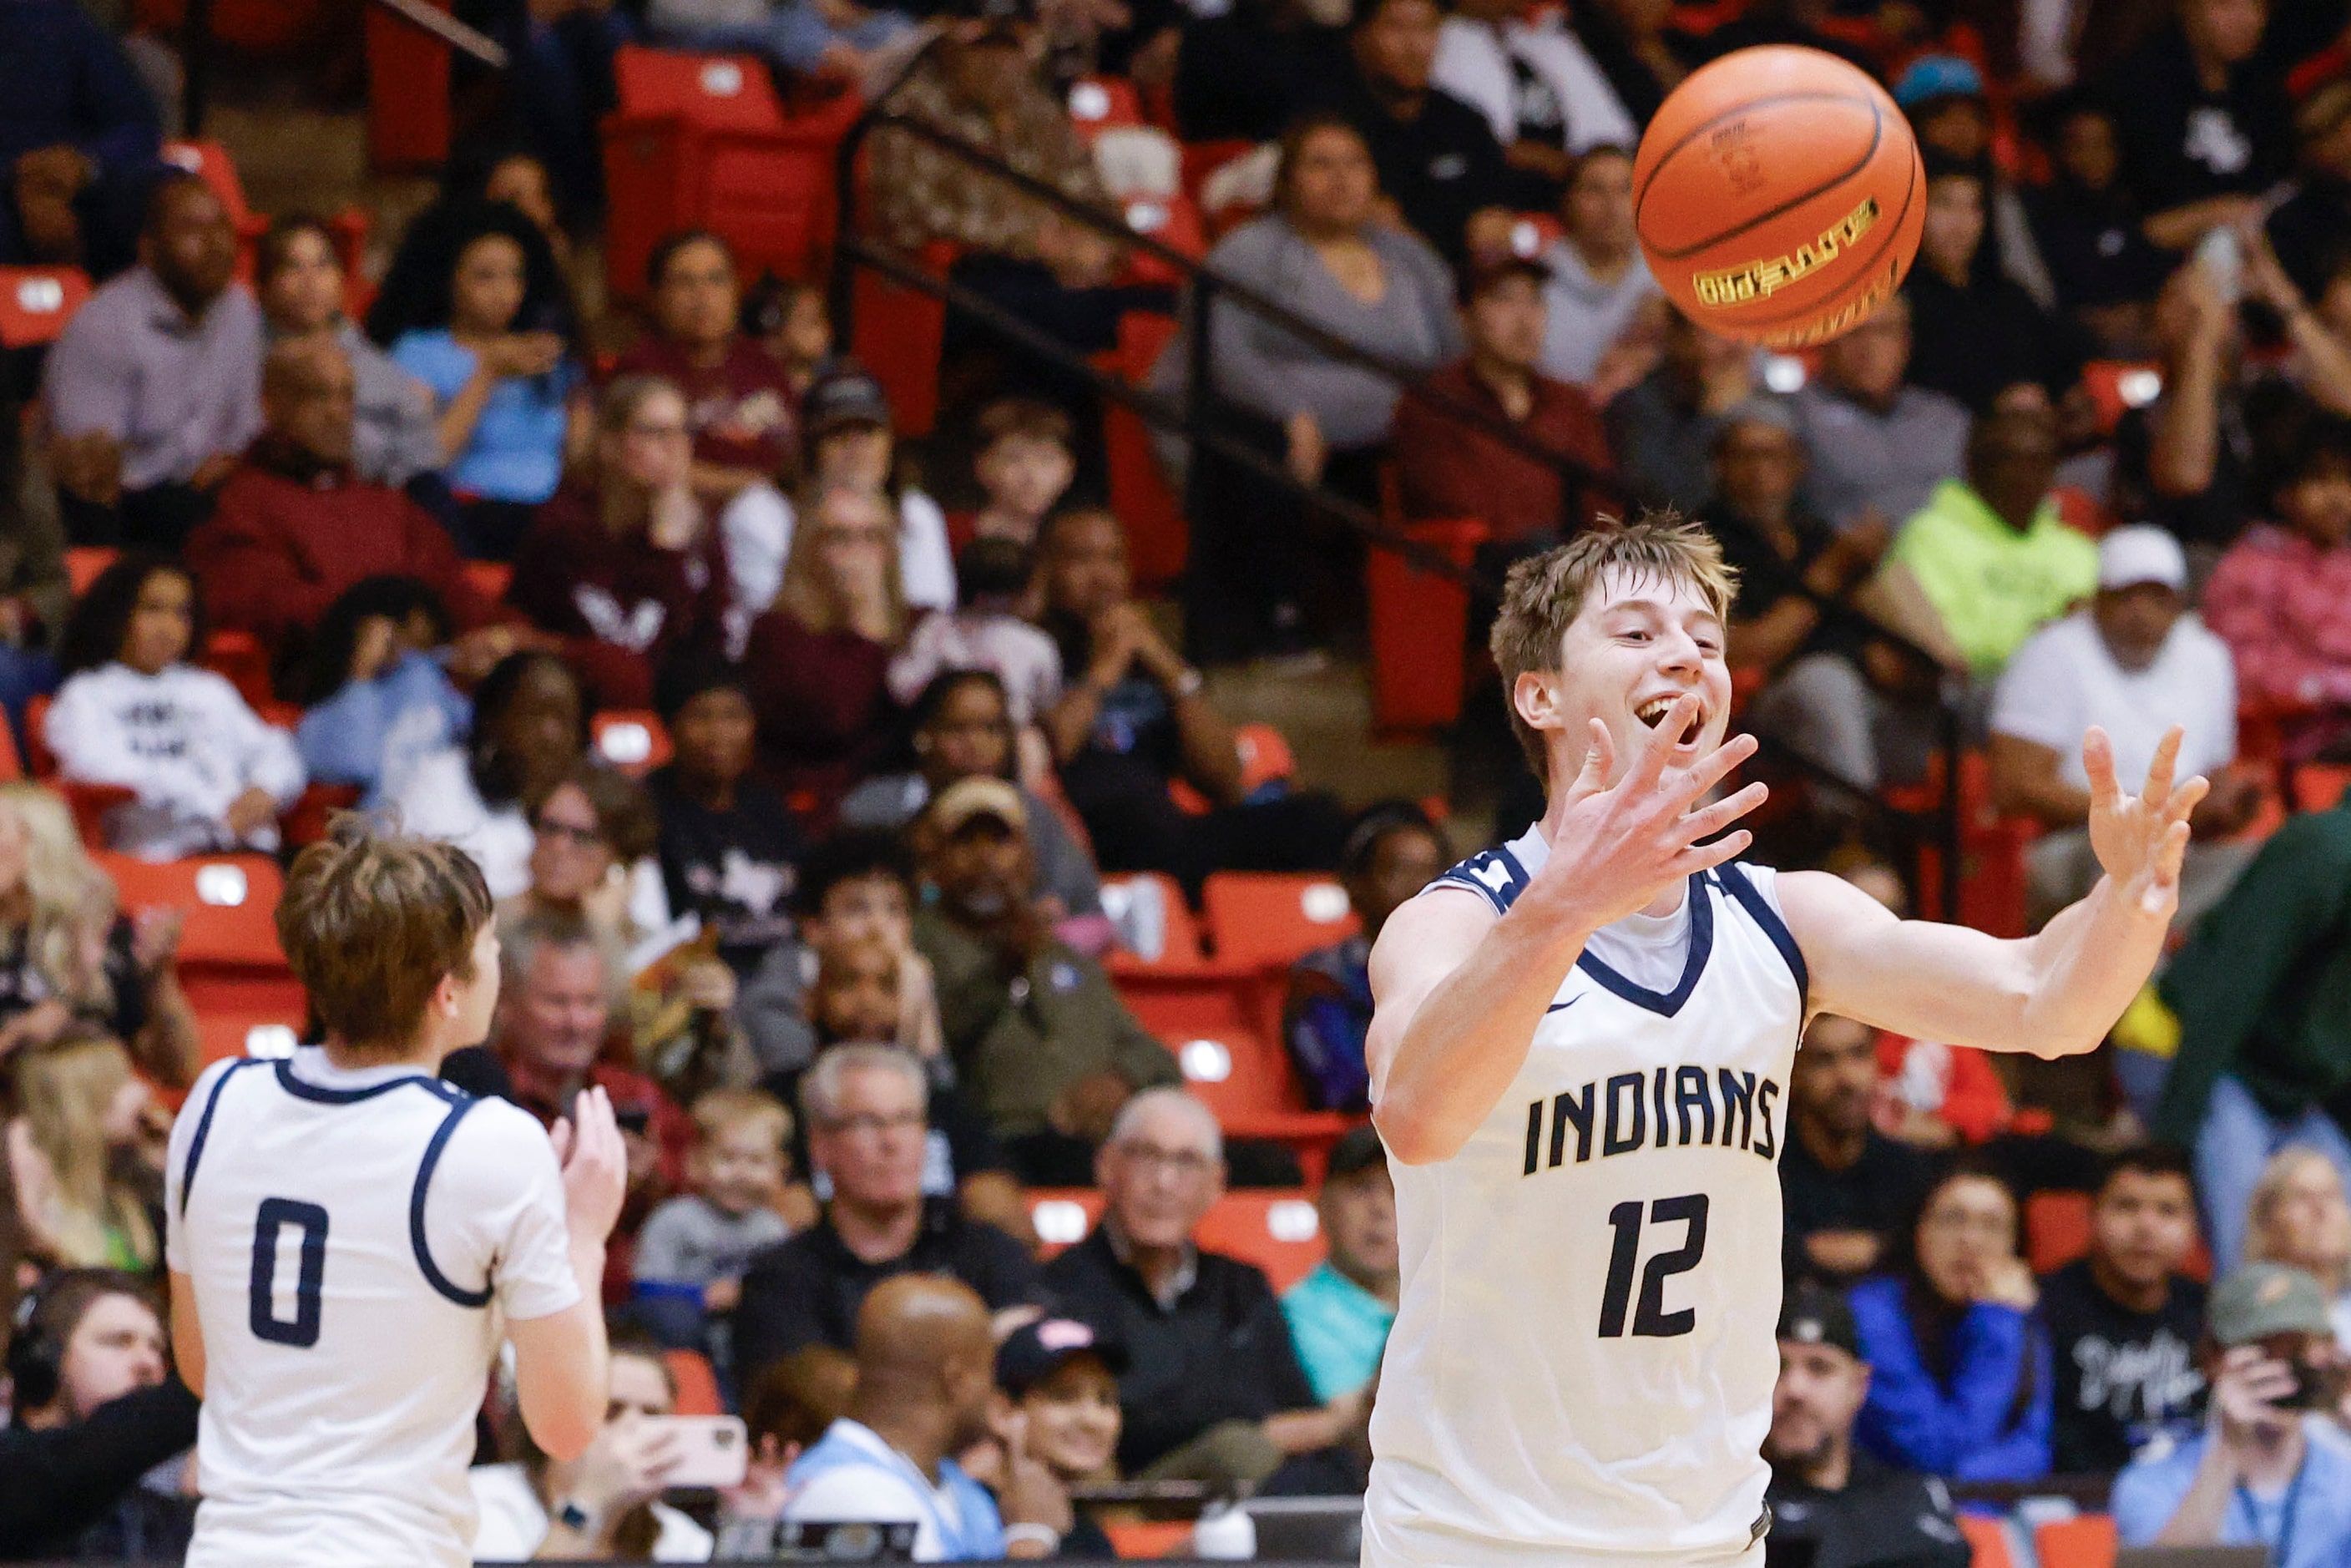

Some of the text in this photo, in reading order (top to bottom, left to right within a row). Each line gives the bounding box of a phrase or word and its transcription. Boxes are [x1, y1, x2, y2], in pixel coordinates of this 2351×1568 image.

[1523, 1065, 1780, 1178] INDIANS
[250, 1197, 329, 1349] 0
[1598, 1193, 1710, 1338] 12
